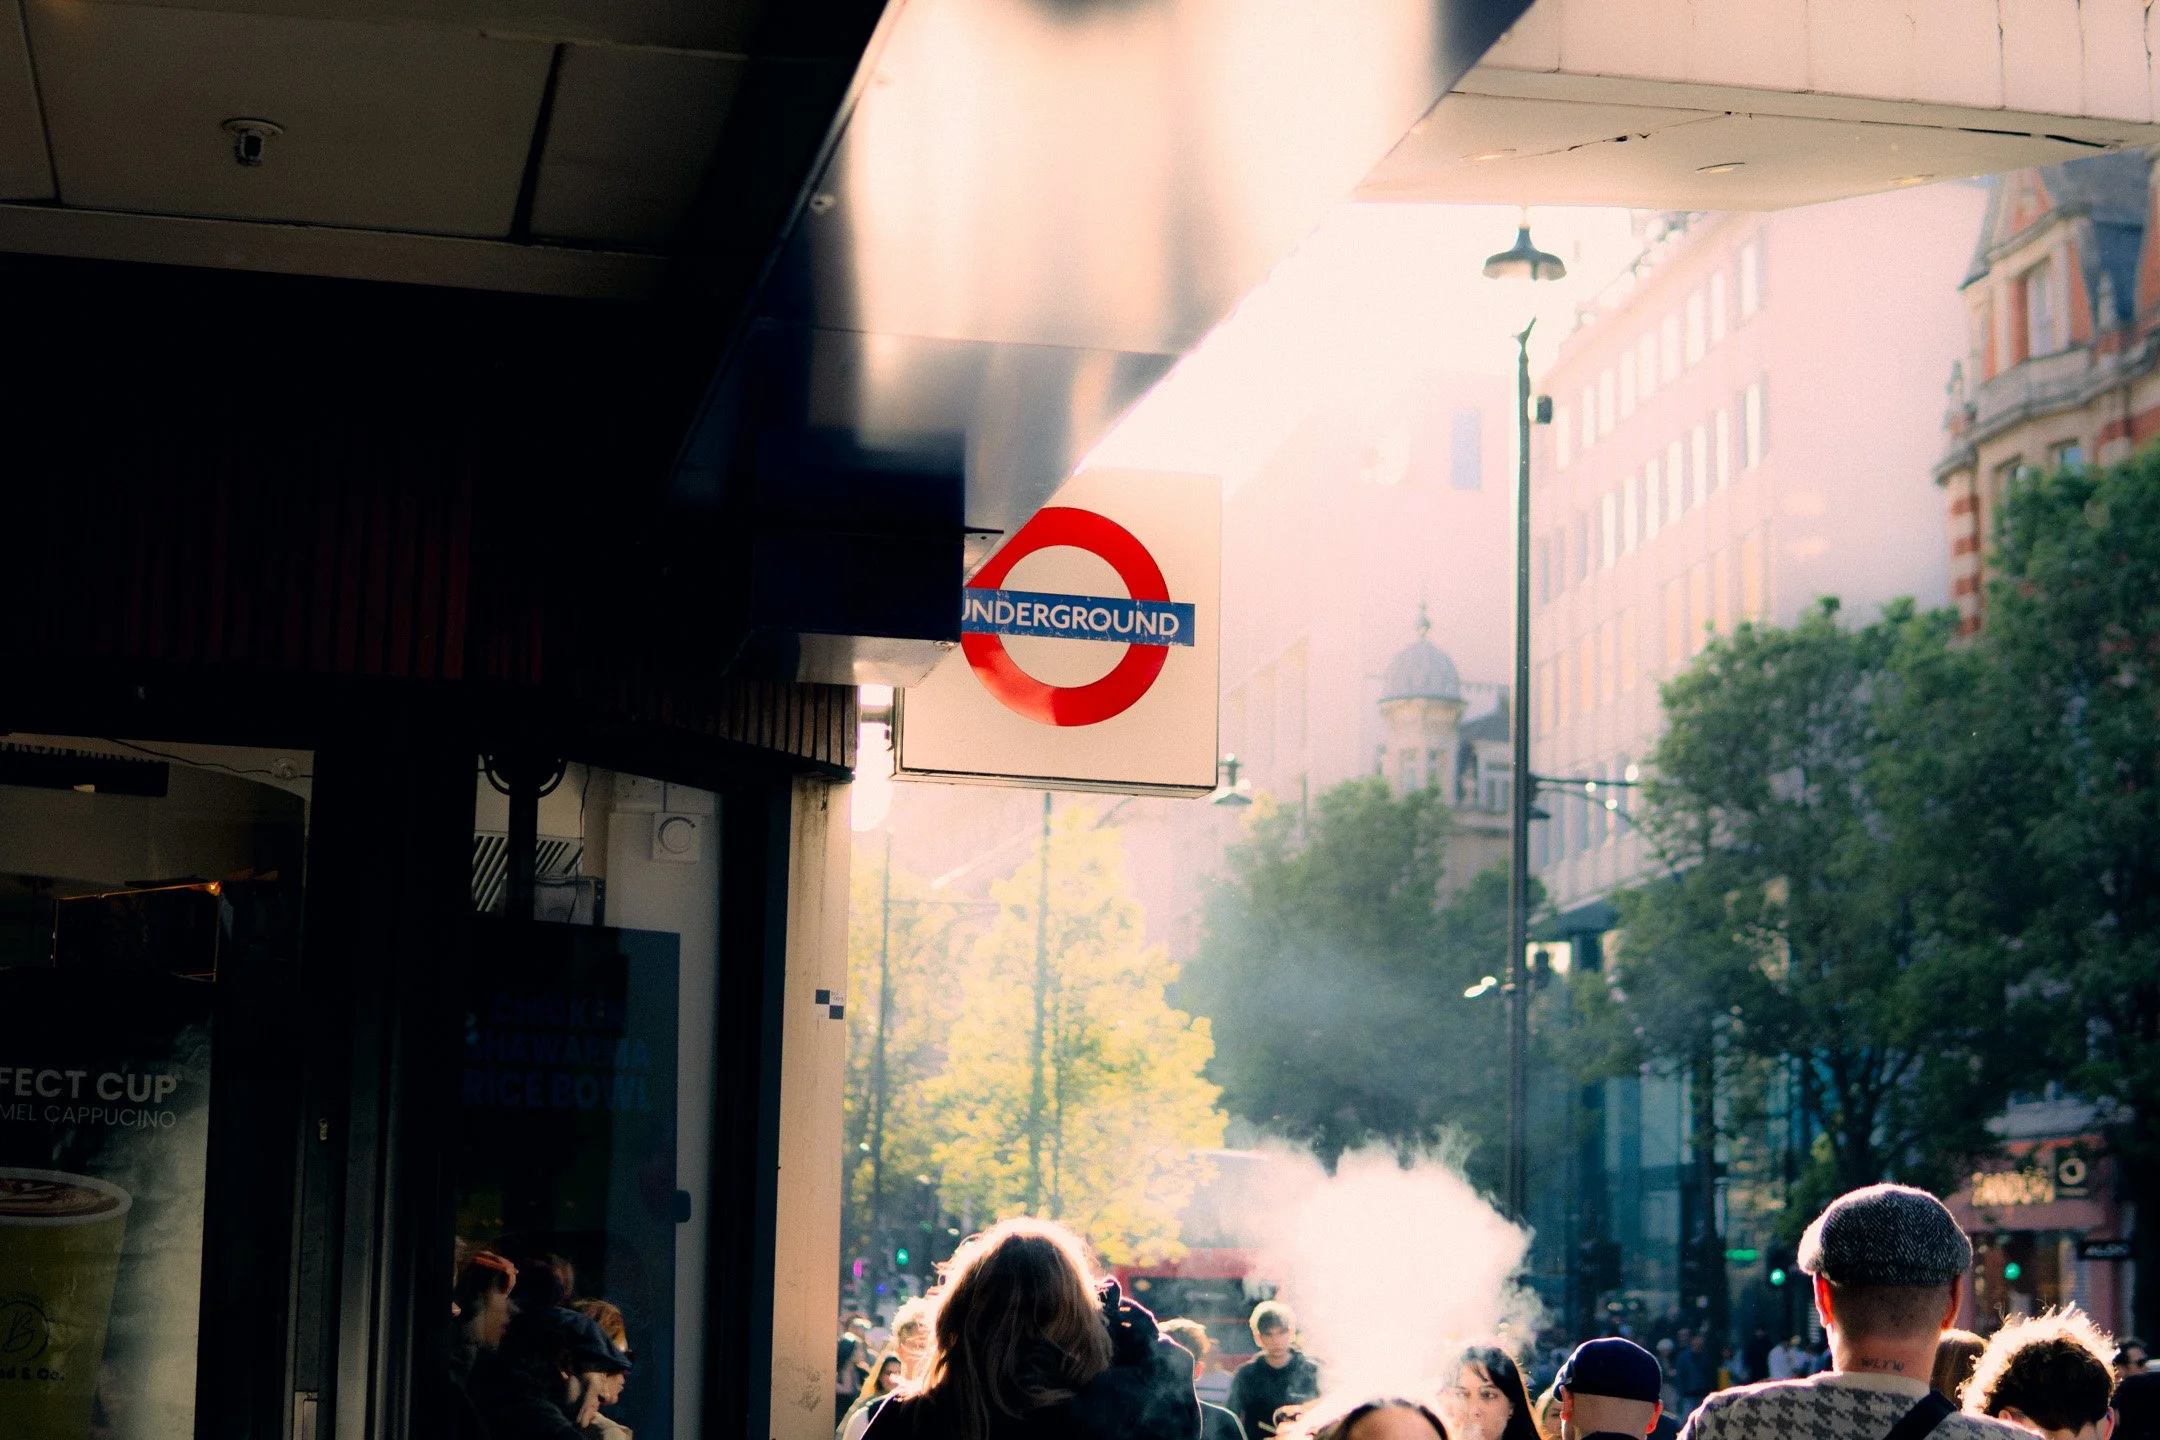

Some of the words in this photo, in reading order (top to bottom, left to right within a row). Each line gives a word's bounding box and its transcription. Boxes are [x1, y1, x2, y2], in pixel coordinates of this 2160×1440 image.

[0, 1066, 88, 1099] FECT
[96, 1071, 178, 1104] CUP
[462, 1068, 544, 1108] RICE
[551, 1073, 653, 1112] BOWL
[0, 1103, 38, 1122] MEL
[44, 1104, 176, 1129] CAPPUCINO
